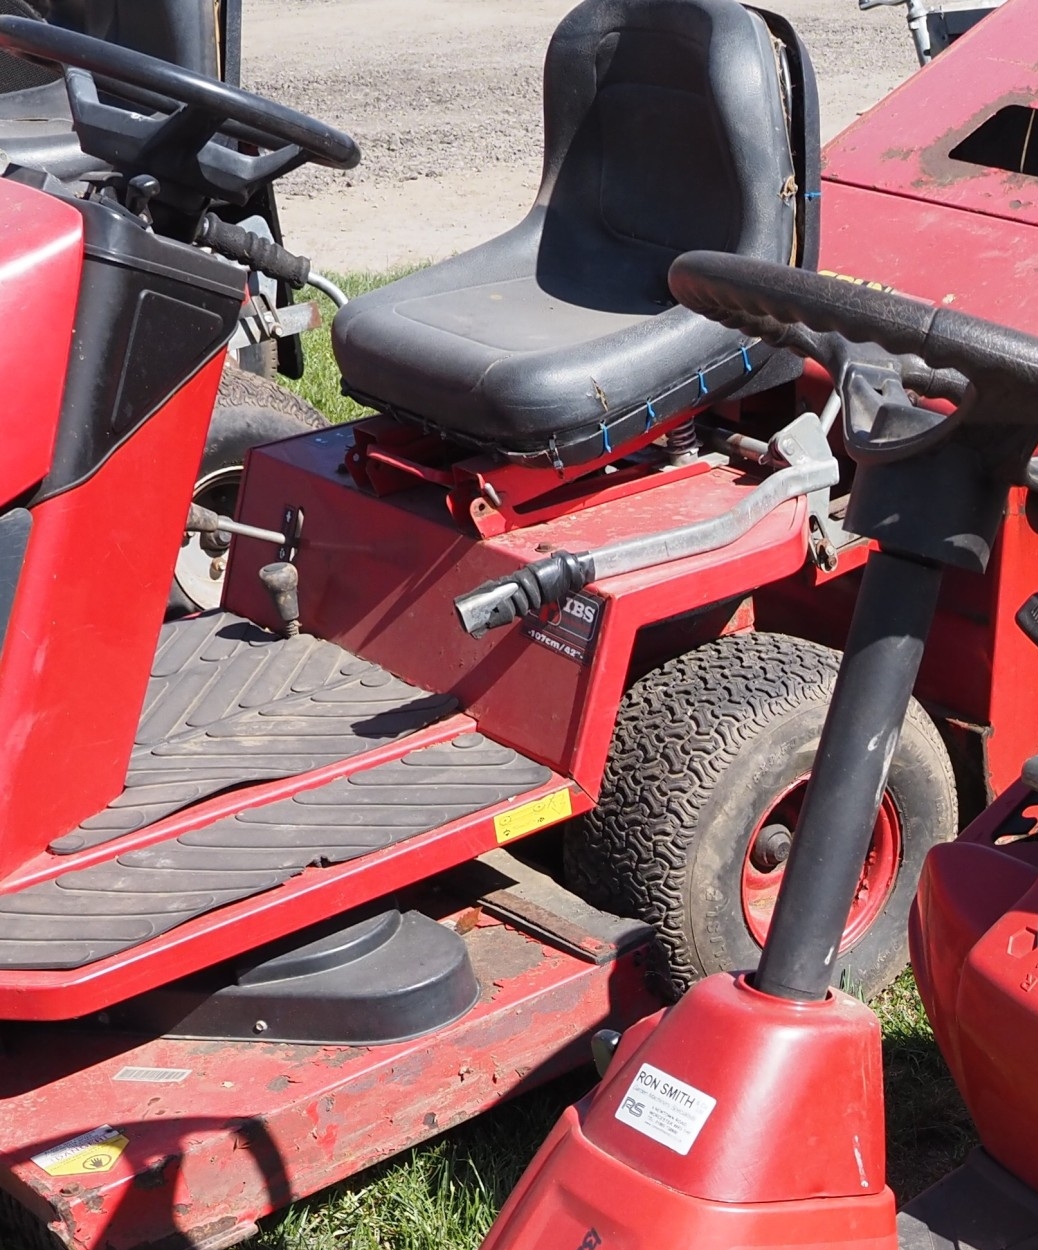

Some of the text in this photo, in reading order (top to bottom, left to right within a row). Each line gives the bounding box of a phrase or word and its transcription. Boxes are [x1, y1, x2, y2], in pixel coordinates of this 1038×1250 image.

[563, 597, 596, 623] IBS
[637, 1071, 661, 1091] RON
[660, 1083, 696, 1108] SMITH
